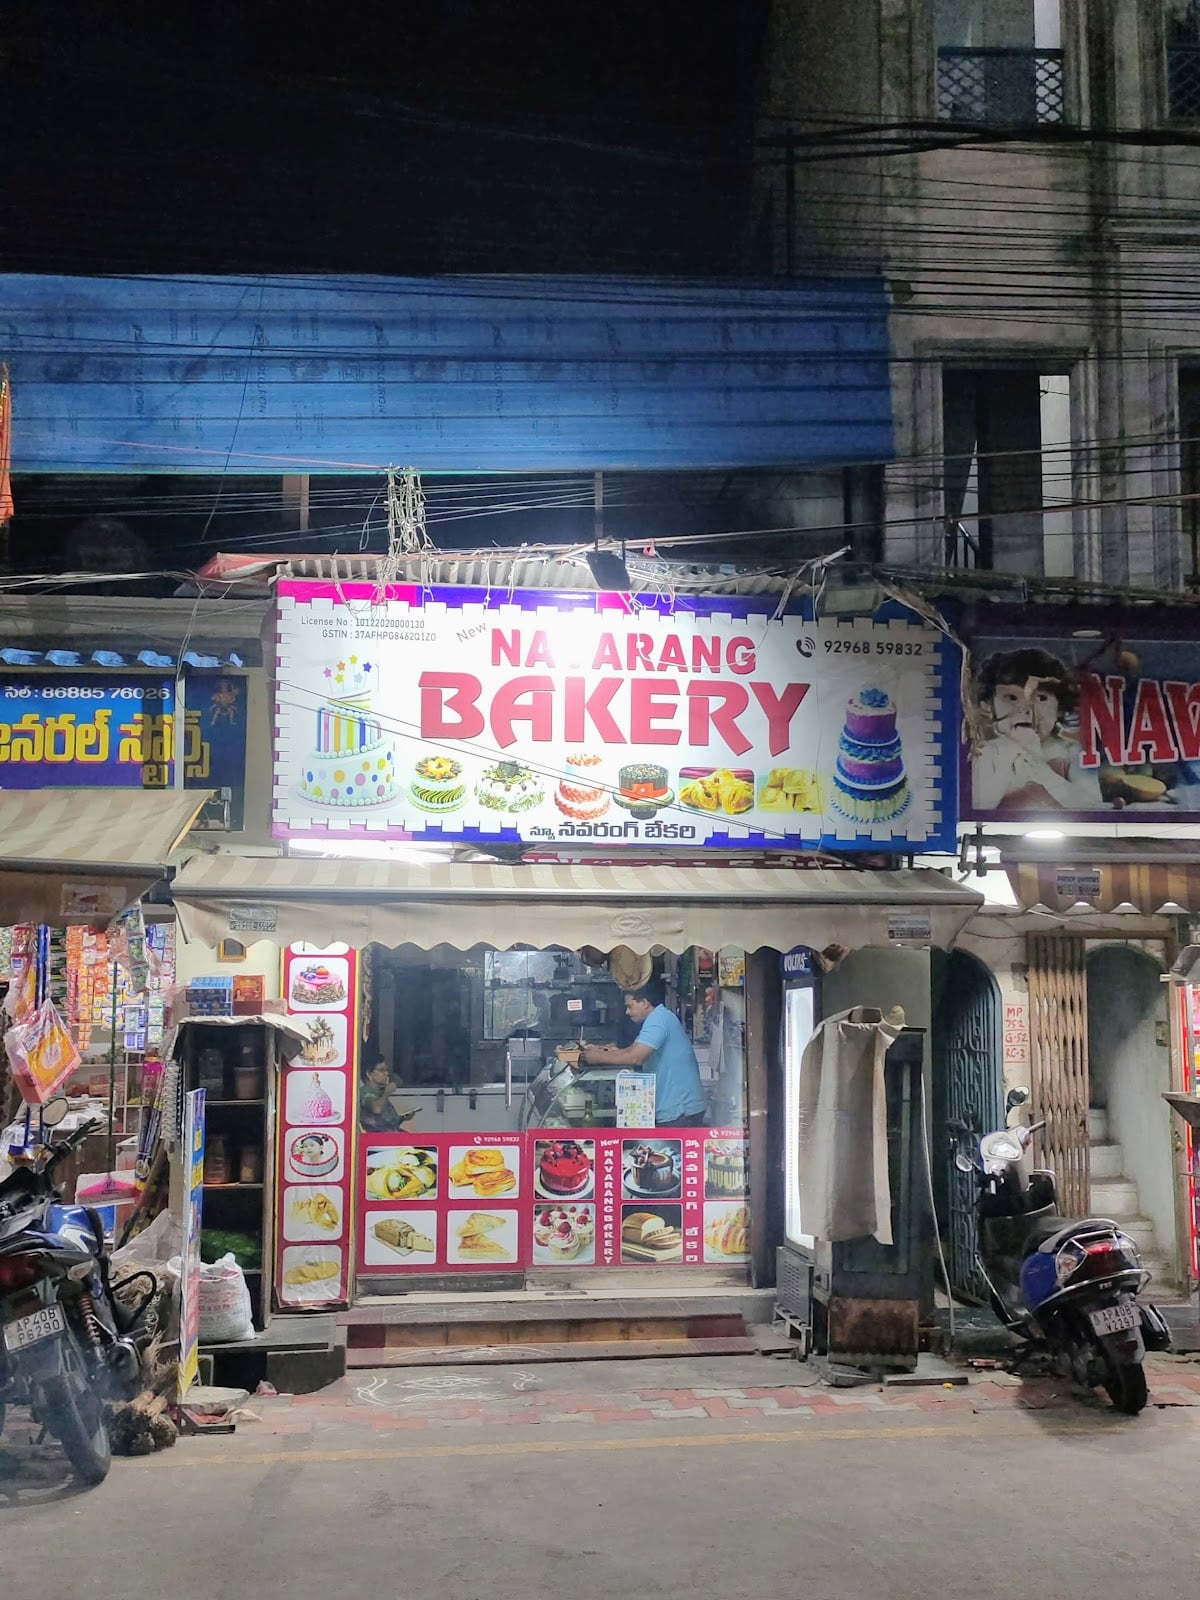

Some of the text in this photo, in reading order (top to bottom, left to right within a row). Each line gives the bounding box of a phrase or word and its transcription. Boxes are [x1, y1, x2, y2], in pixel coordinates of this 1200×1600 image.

[301, 617, 334, 626] License
[336, 617, 348, 627] No
[322, 629, 348, 639] GSTIN
[455, 622, 487, 643] New
[491, 627, 756, 675] NAARANG
[824, 639, 923, 656] 92968 59832
[42, 686, 105, 699] 86885
[110, 686, 171, 700] 76026
[418, 671, 811, 757] BAKERY
[558, 821, 640, 838] నవరంగ్
[1006, 1007, 1023, 1017] MP
[1005, 1019, 1025, 1028] 752
[600, 1138, 620, 1147] New
[603, 1150, 614, 1264] NAVARANG BAKERY
